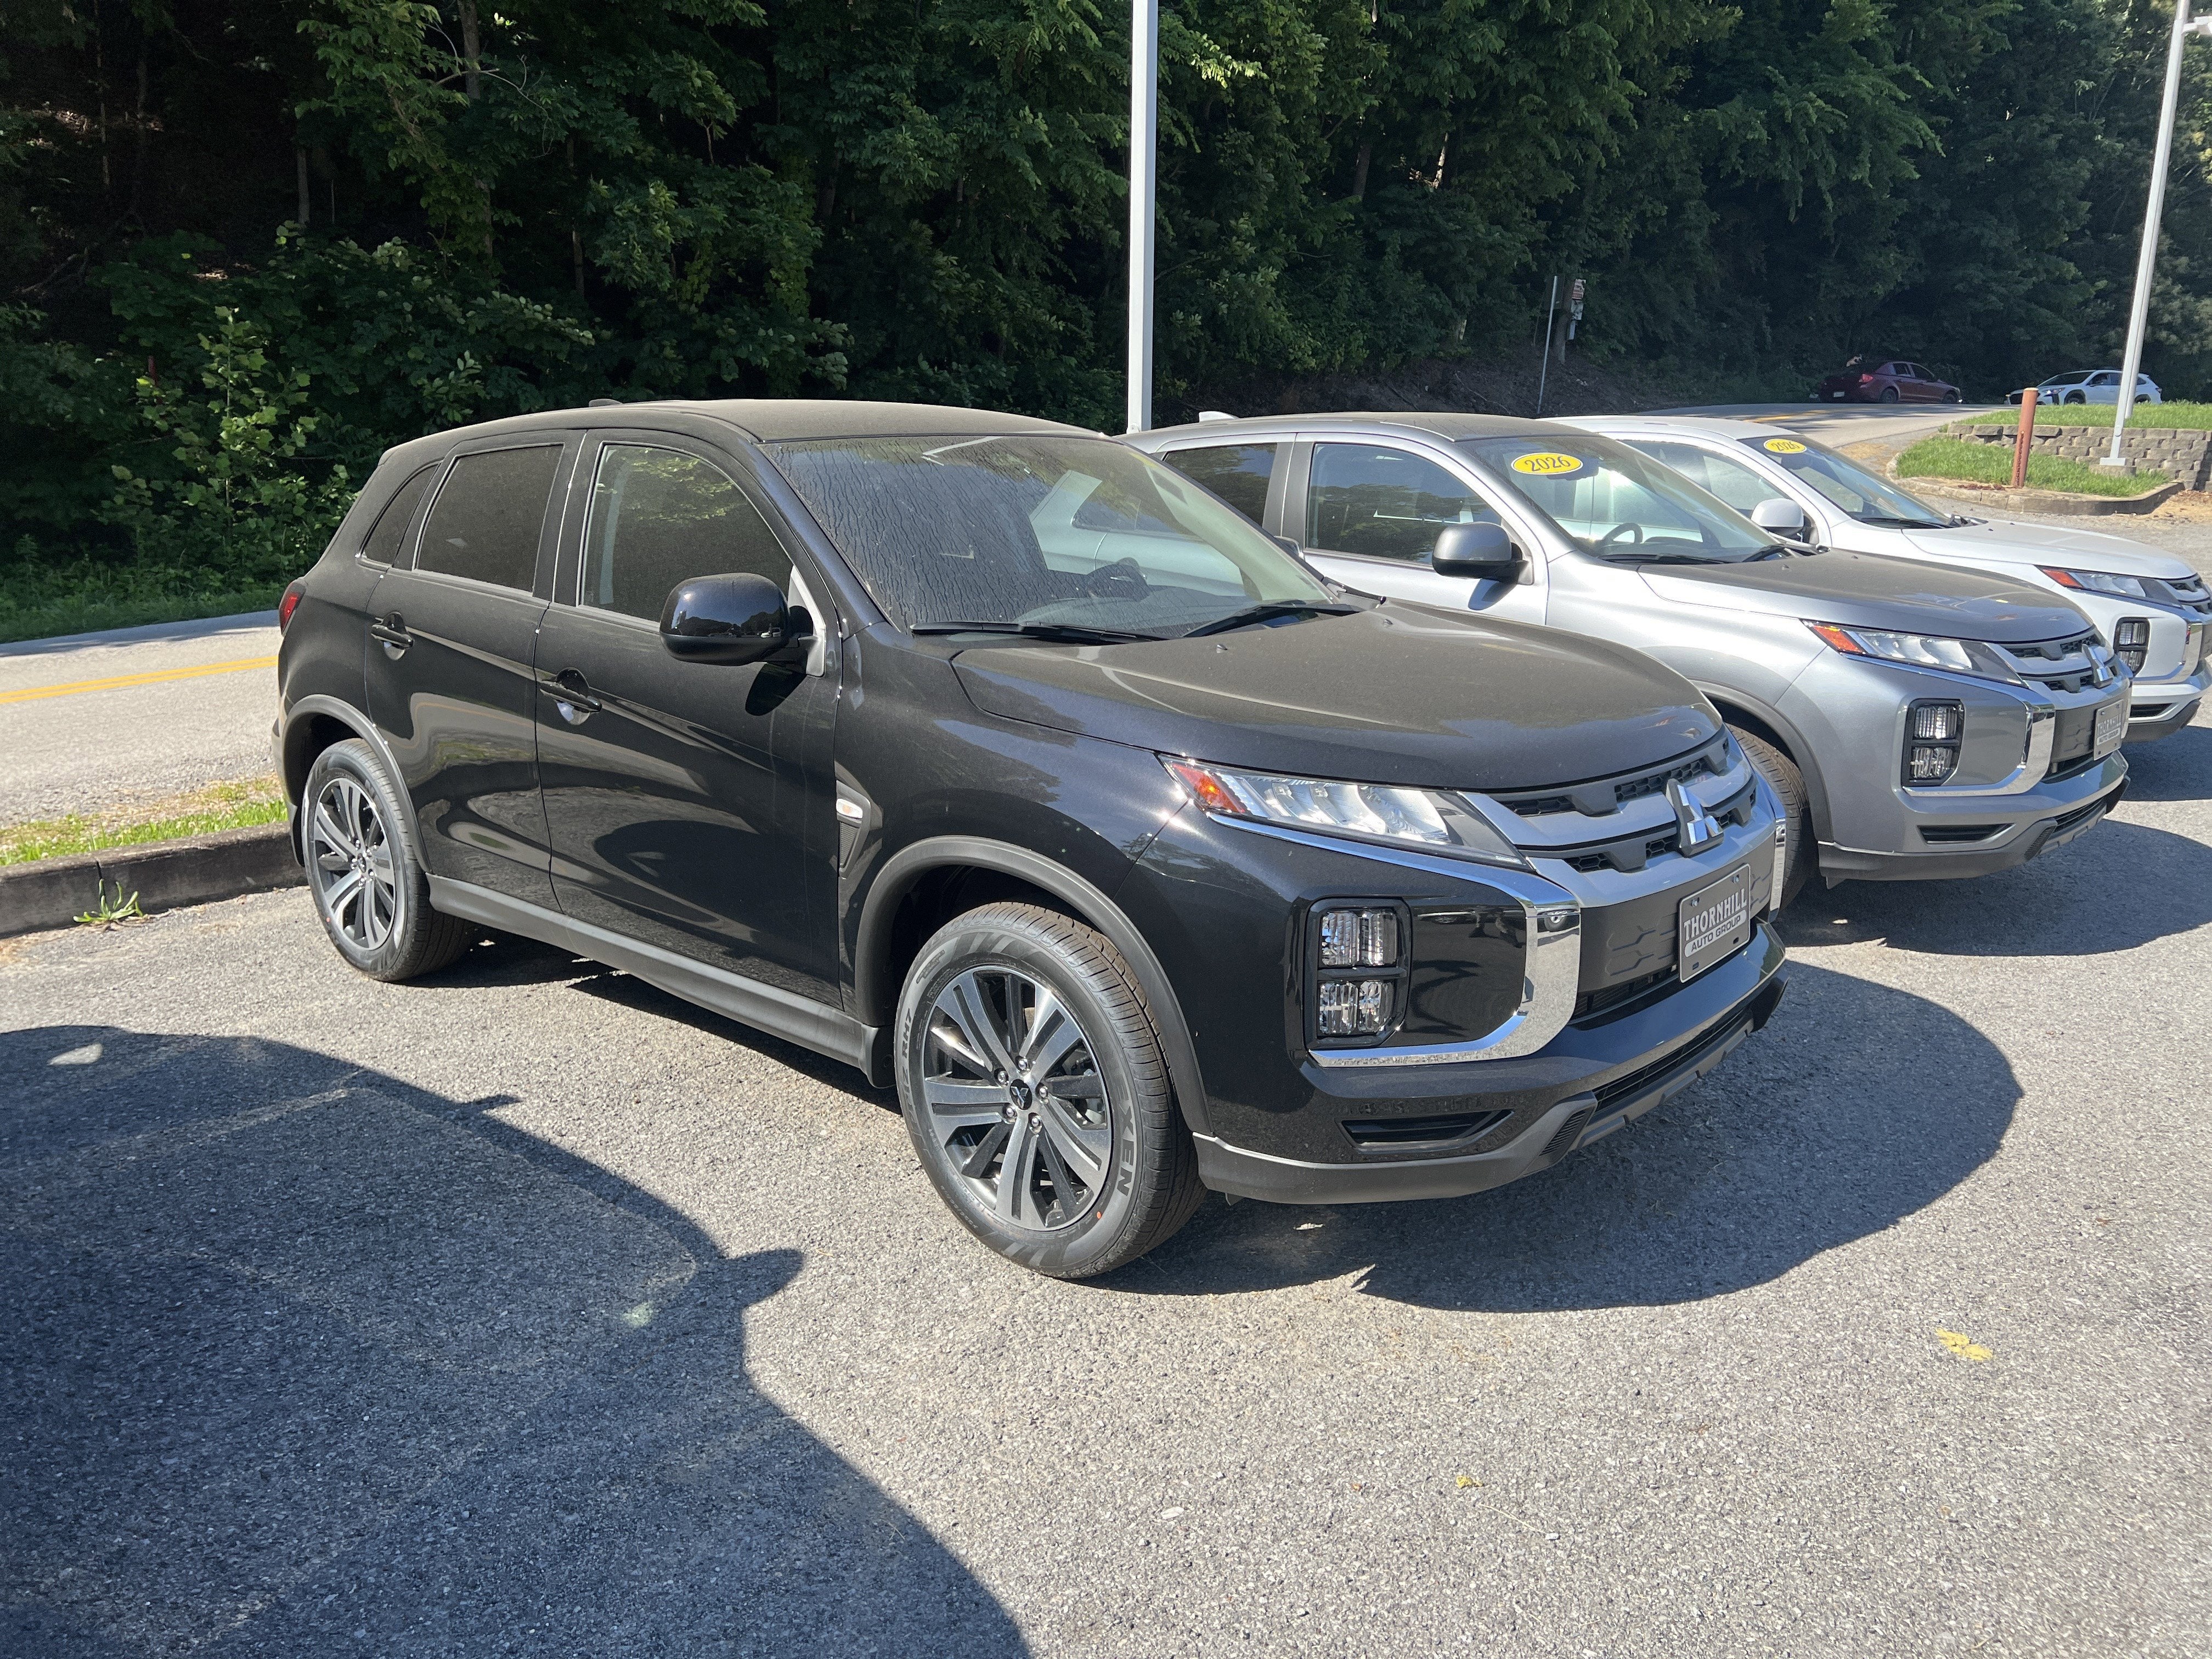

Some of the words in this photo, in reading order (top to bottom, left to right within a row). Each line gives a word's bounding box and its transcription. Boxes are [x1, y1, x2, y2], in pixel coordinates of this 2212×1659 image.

[1524, 456, 1571, 472] 2026
[1684, 888, 1747, 941] THORNHILL
[1691, 933, 1713, 952] AUTO
[1716, 916, 1741, 937] GROUP
[902, 1008, 911, 1059] RH7
